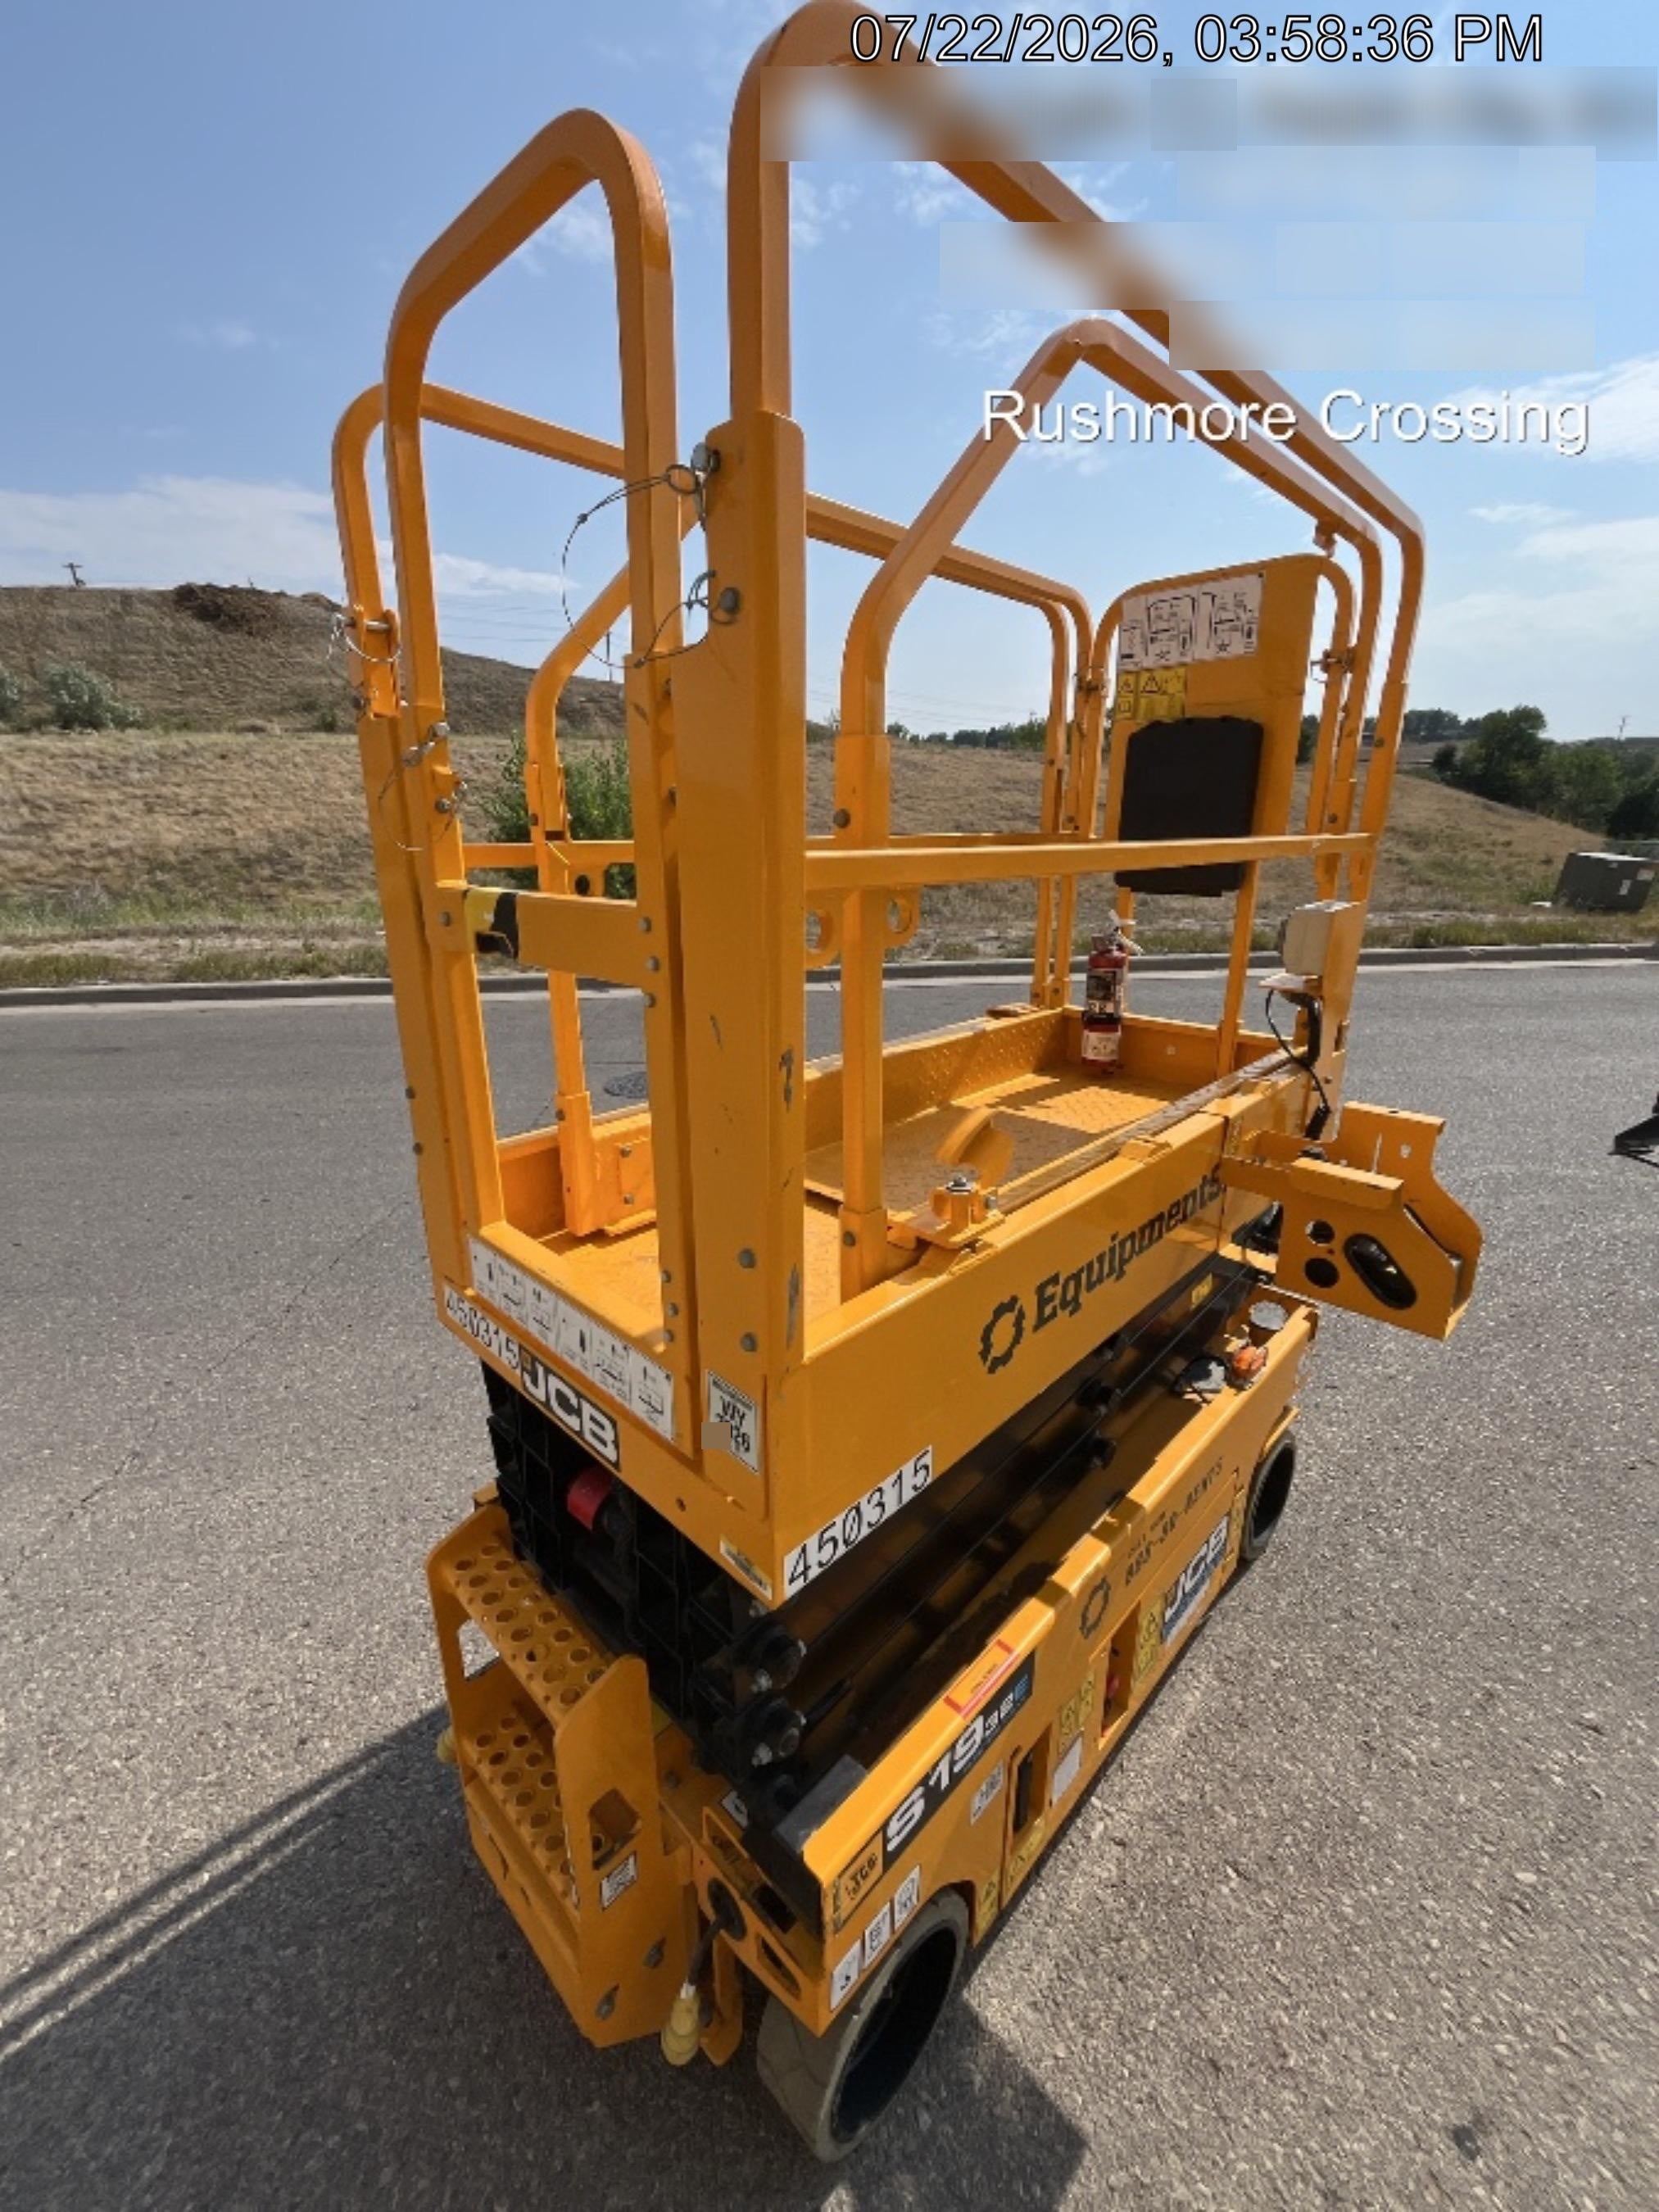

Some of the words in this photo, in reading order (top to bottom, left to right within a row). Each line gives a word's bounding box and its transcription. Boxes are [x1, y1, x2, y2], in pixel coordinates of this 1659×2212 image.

[445, 1289, 519, 1371] 450315
[523, 1358, 618, 1465] JCB
[787, 1449, 931, 1587] 450315
[1163, 1515, 1229, 1623] JCB
